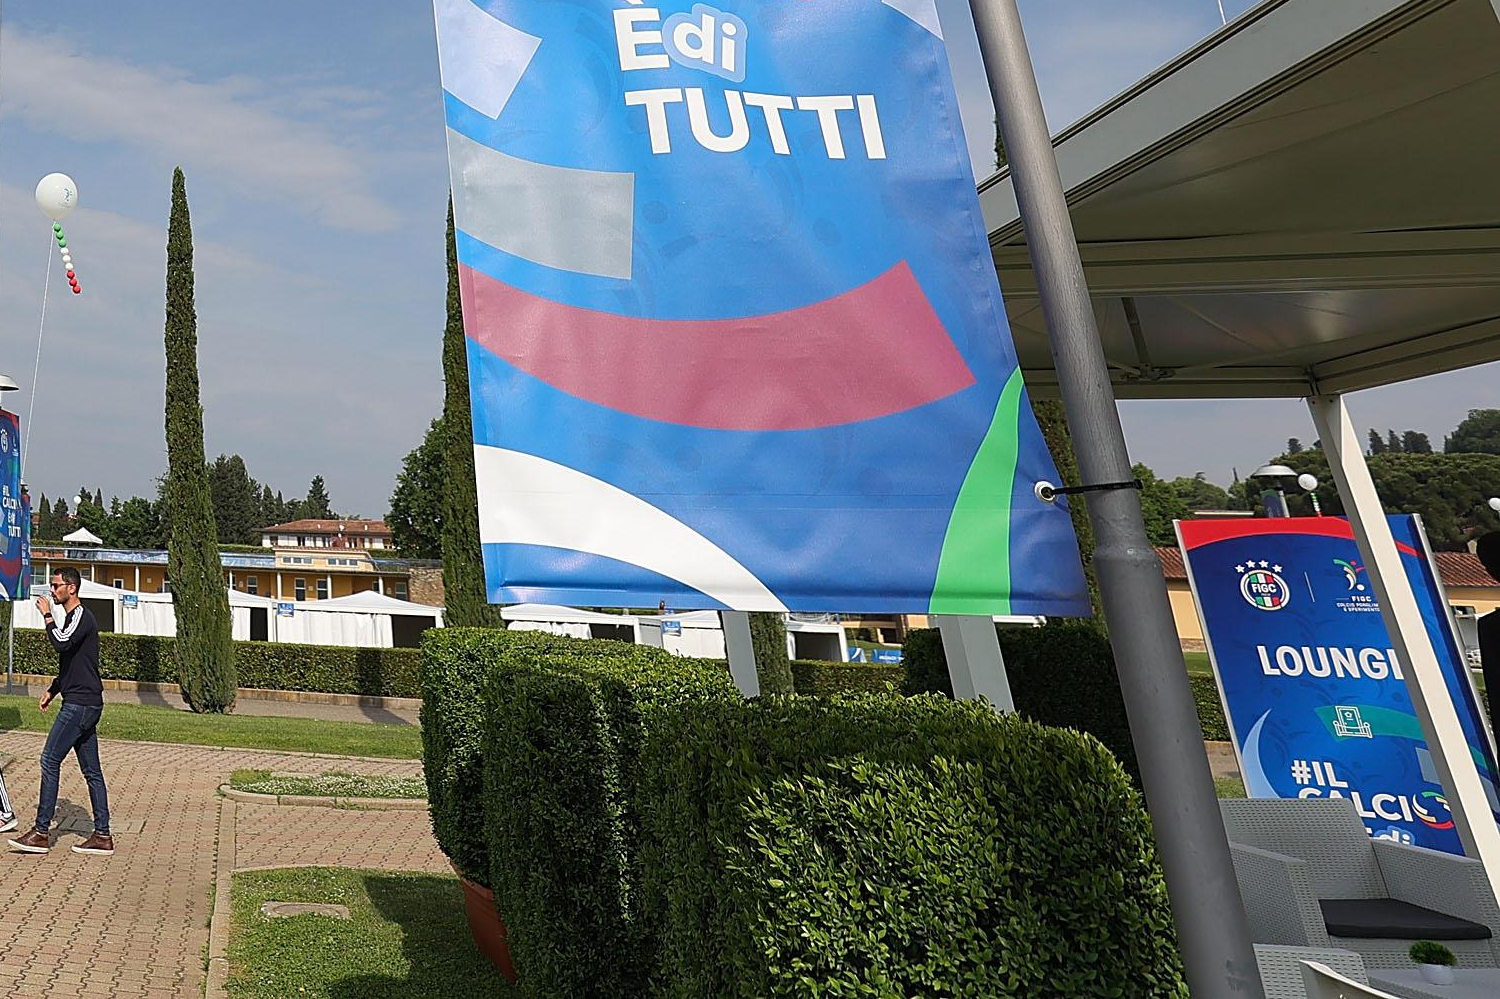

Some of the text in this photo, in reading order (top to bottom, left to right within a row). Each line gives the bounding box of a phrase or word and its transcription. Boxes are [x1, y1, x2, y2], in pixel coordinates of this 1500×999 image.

[624, 87, 887, 160] TUTTI
[1251, 583, 1277, 593] FIGC
[1290, 759, 1348, 788] #IL
